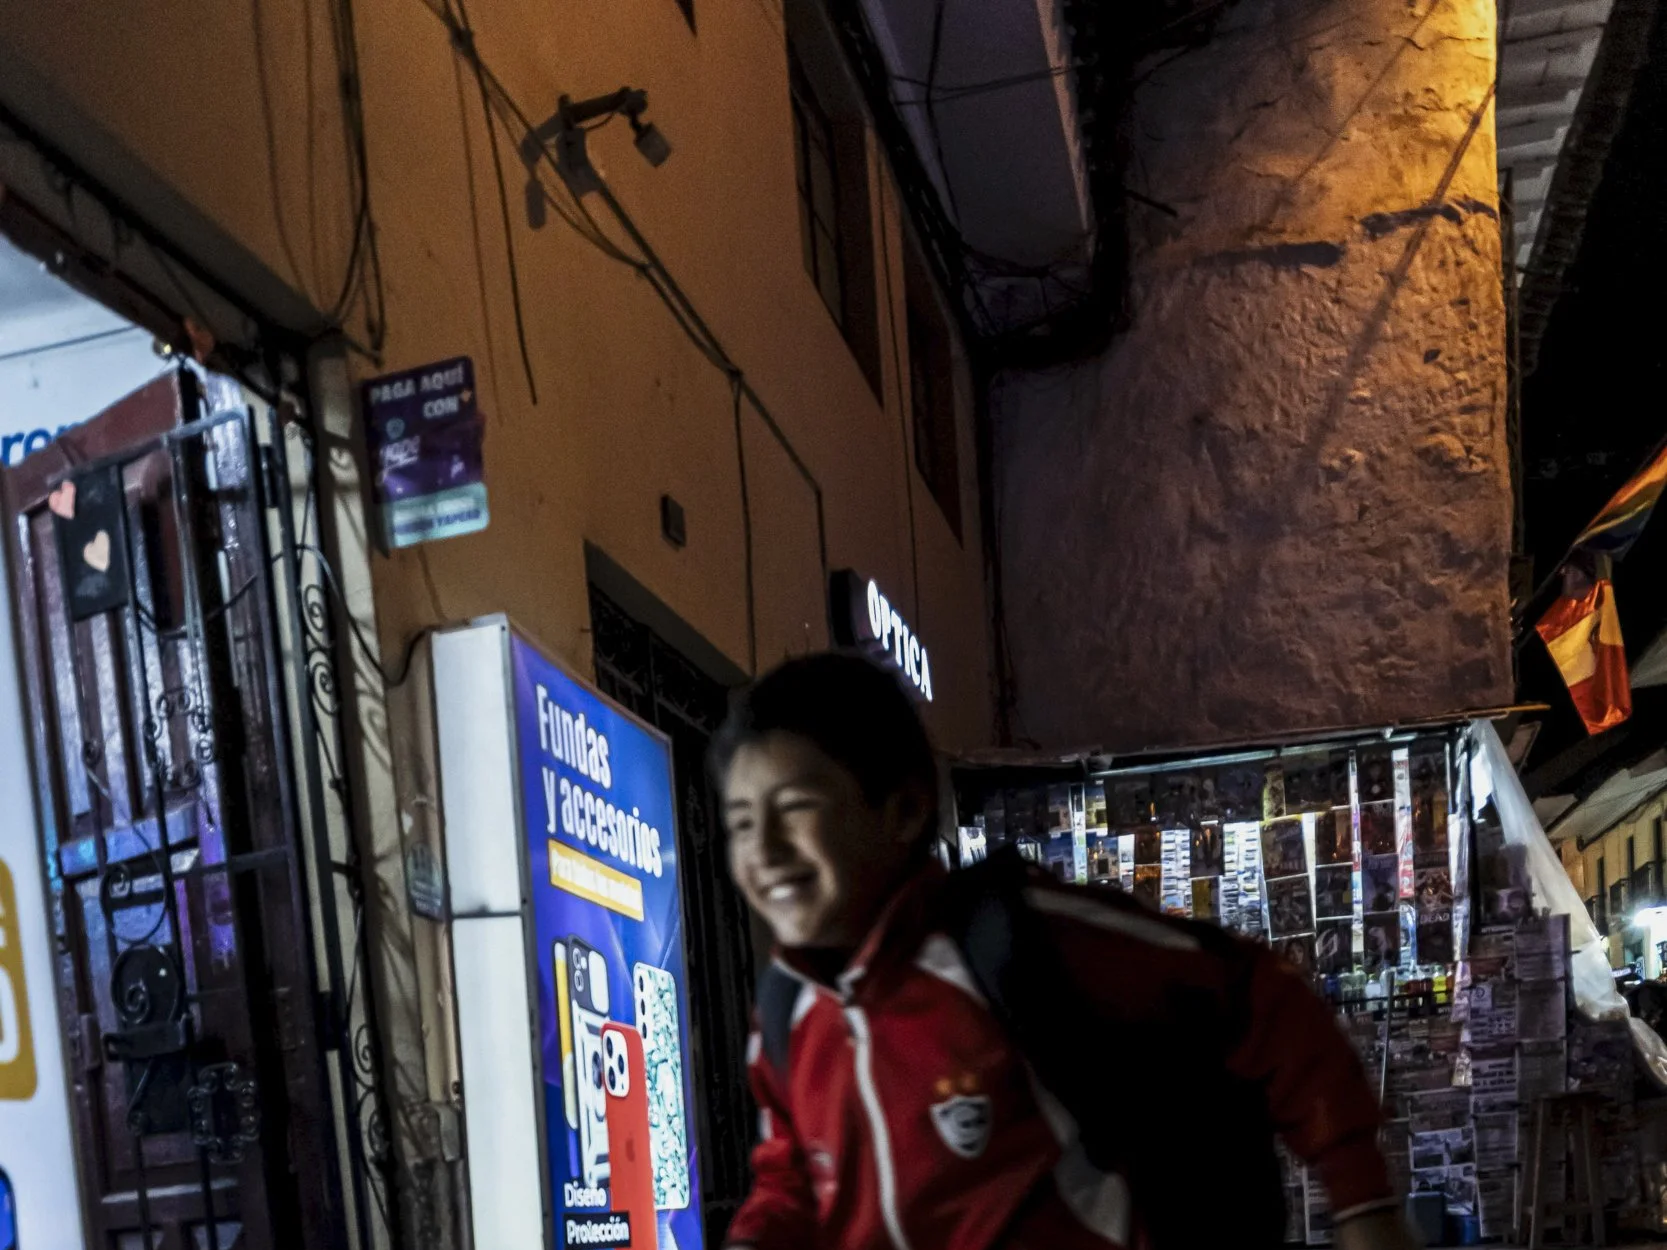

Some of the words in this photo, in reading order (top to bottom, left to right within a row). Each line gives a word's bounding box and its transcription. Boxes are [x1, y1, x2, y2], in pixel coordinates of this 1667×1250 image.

[423, 396, 459, 419] CON
[867, 579, 933, 702] OPTICA
[536, 683, 611, 789] Fundas
[542, 766, 556, 834] y
[560, 777, 663, 878] accesorios
[566, 1215, 630, 1245] Protección
